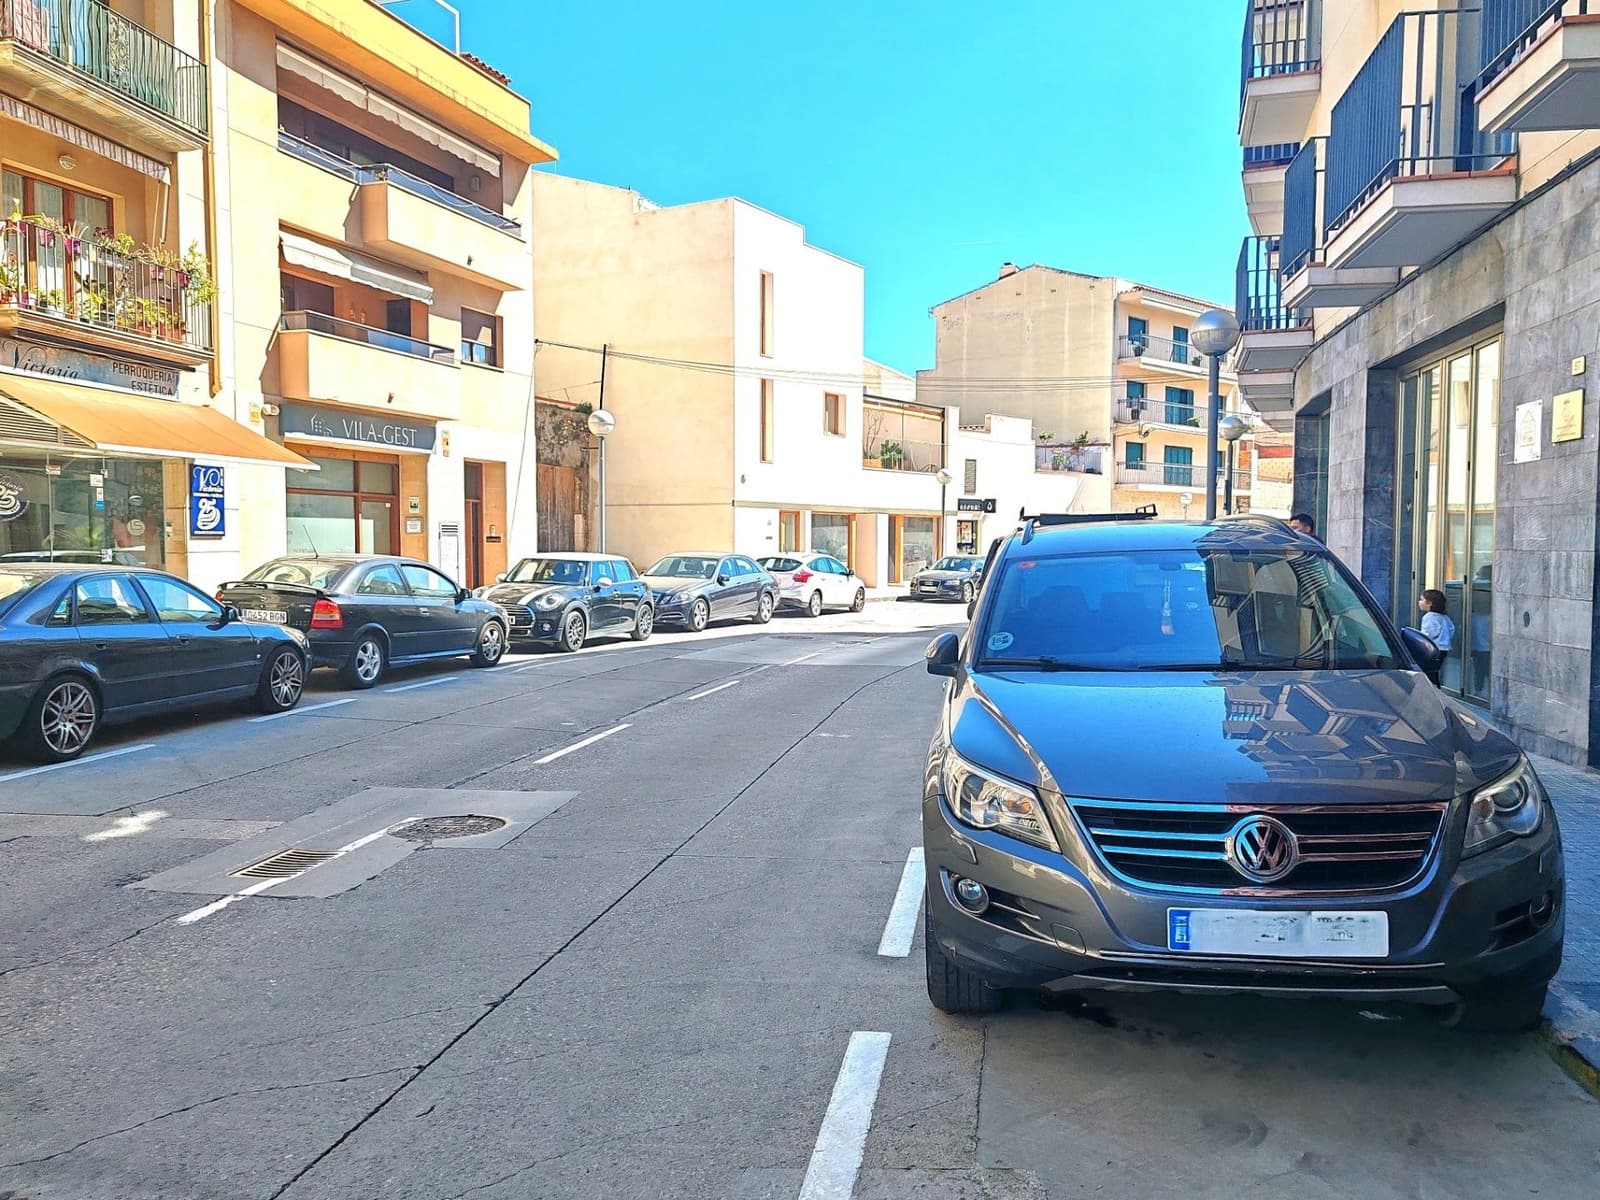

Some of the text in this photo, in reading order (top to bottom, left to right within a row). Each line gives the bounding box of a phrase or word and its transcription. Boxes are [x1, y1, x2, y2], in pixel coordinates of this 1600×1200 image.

[2, 340, 79, 379] Victoria
[112, 362, 174, 383] PERRUQUERIA
[342, 418, 417, 446] VILA-GEST
